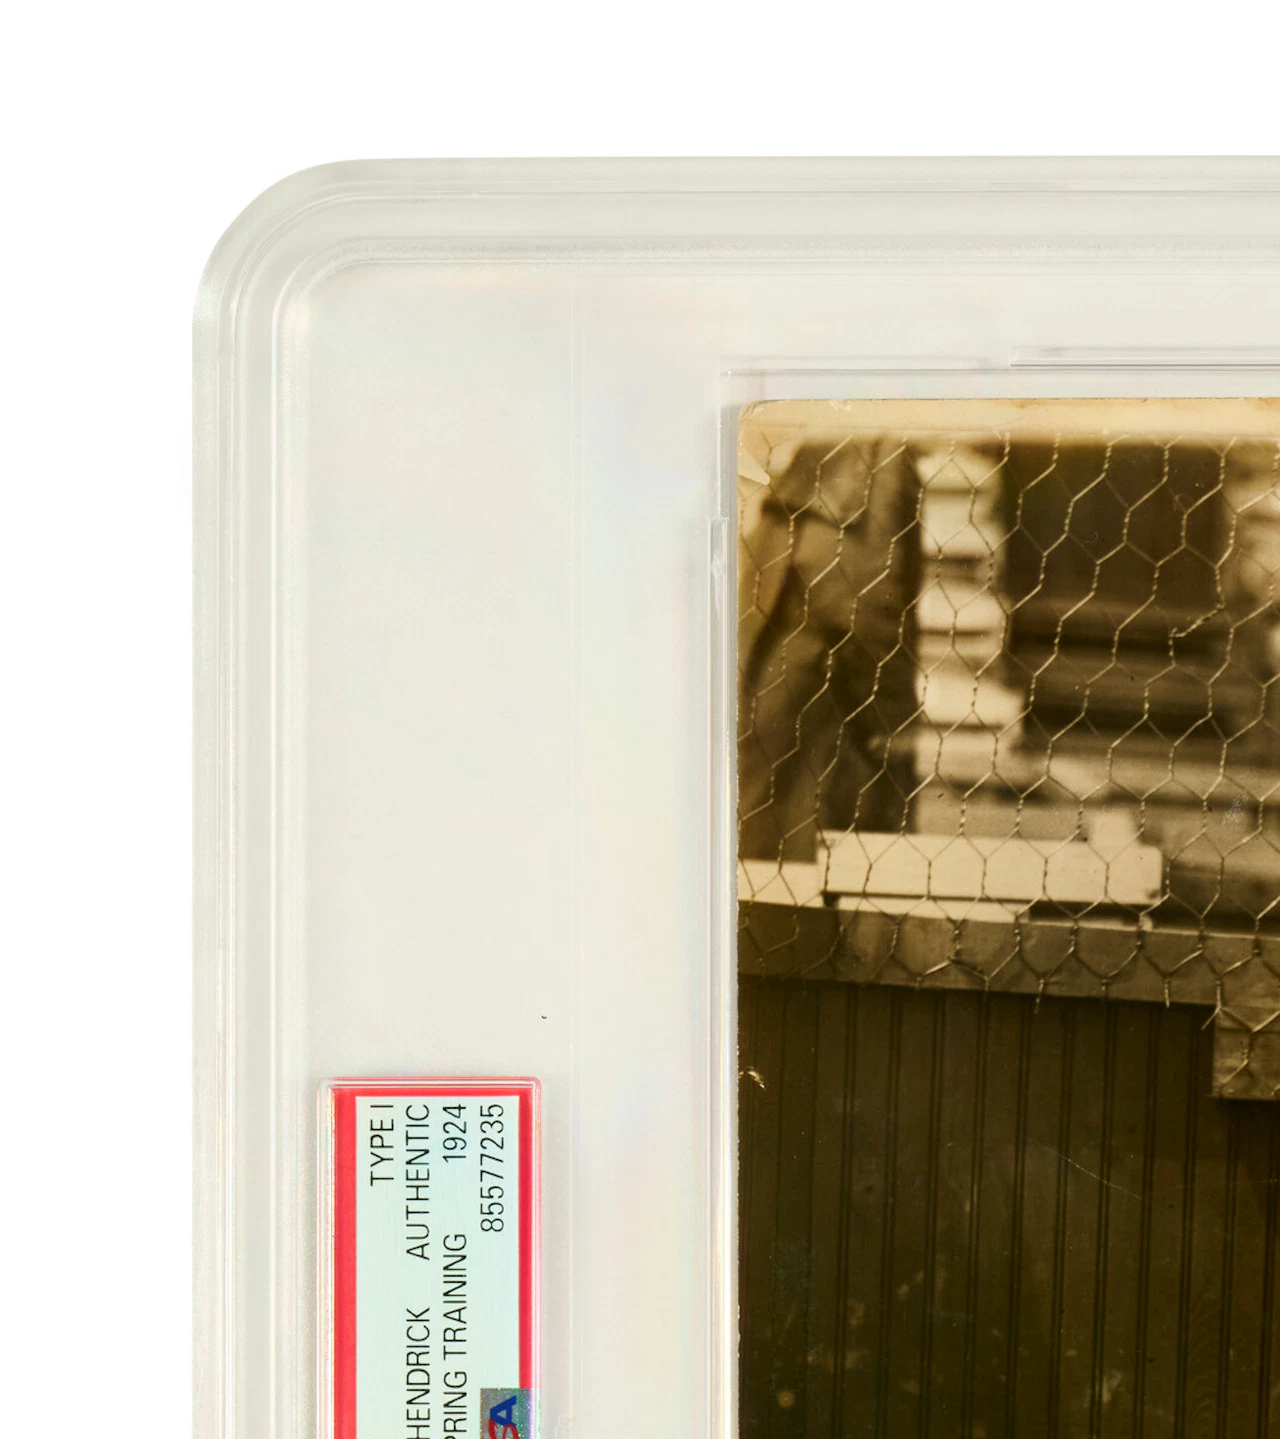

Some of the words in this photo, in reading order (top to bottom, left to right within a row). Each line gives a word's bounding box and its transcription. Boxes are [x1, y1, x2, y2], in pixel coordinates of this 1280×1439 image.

[369, 1118, 395, 1187] TYPE
[405, 1104, 430, 1261] AUTHENTIC
[442, 1104, 467, 1163] 1924
[479, 1104, 505, 1233] 85577235
[442, 1234, 467, 1361] TRAINING
